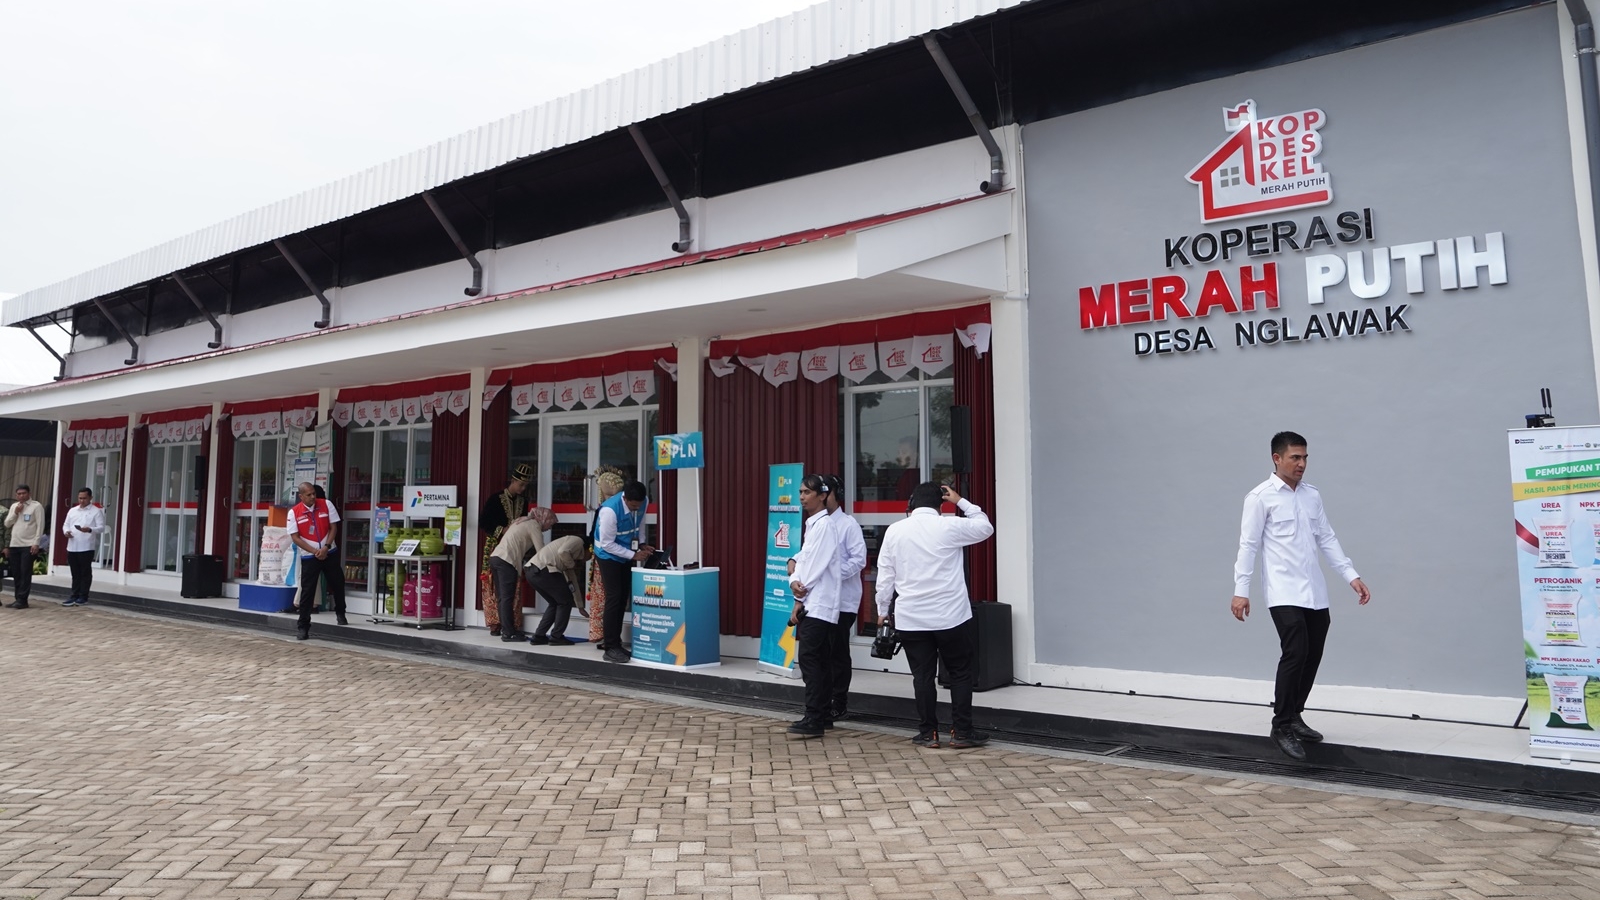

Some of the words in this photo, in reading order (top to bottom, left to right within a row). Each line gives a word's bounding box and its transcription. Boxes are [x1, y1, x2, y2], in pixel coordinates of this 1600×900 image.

[1257, 110, 1319, 140] KOP
[1259, 133, 1316, 162] DES
[1261, 156, 1315, 182] KEL
[1261, 183, 1295, 195] MERAH
[1297, 177, 1326, 189] PUTIH
[1164, 207, 1375, 269] KOPERASI
[1078, 262, 1281, 331] MERAH
[1305, 231, 1509, 305] PUTIH
[1133, 326, 1215, 357] DESA
[1234, 303, 1412, 348] NGLAWAK
[672, 442, 696, 458] PLN
[1535, 464, 1592, 476] PEMUPUKAN
[1524, 486, 1545, 494] HASIL
[1547, 484, 1570, 492] PANEN
[644, 584, 664, 597] MITRA
[660, 599, 682, 609] LISTRIK
